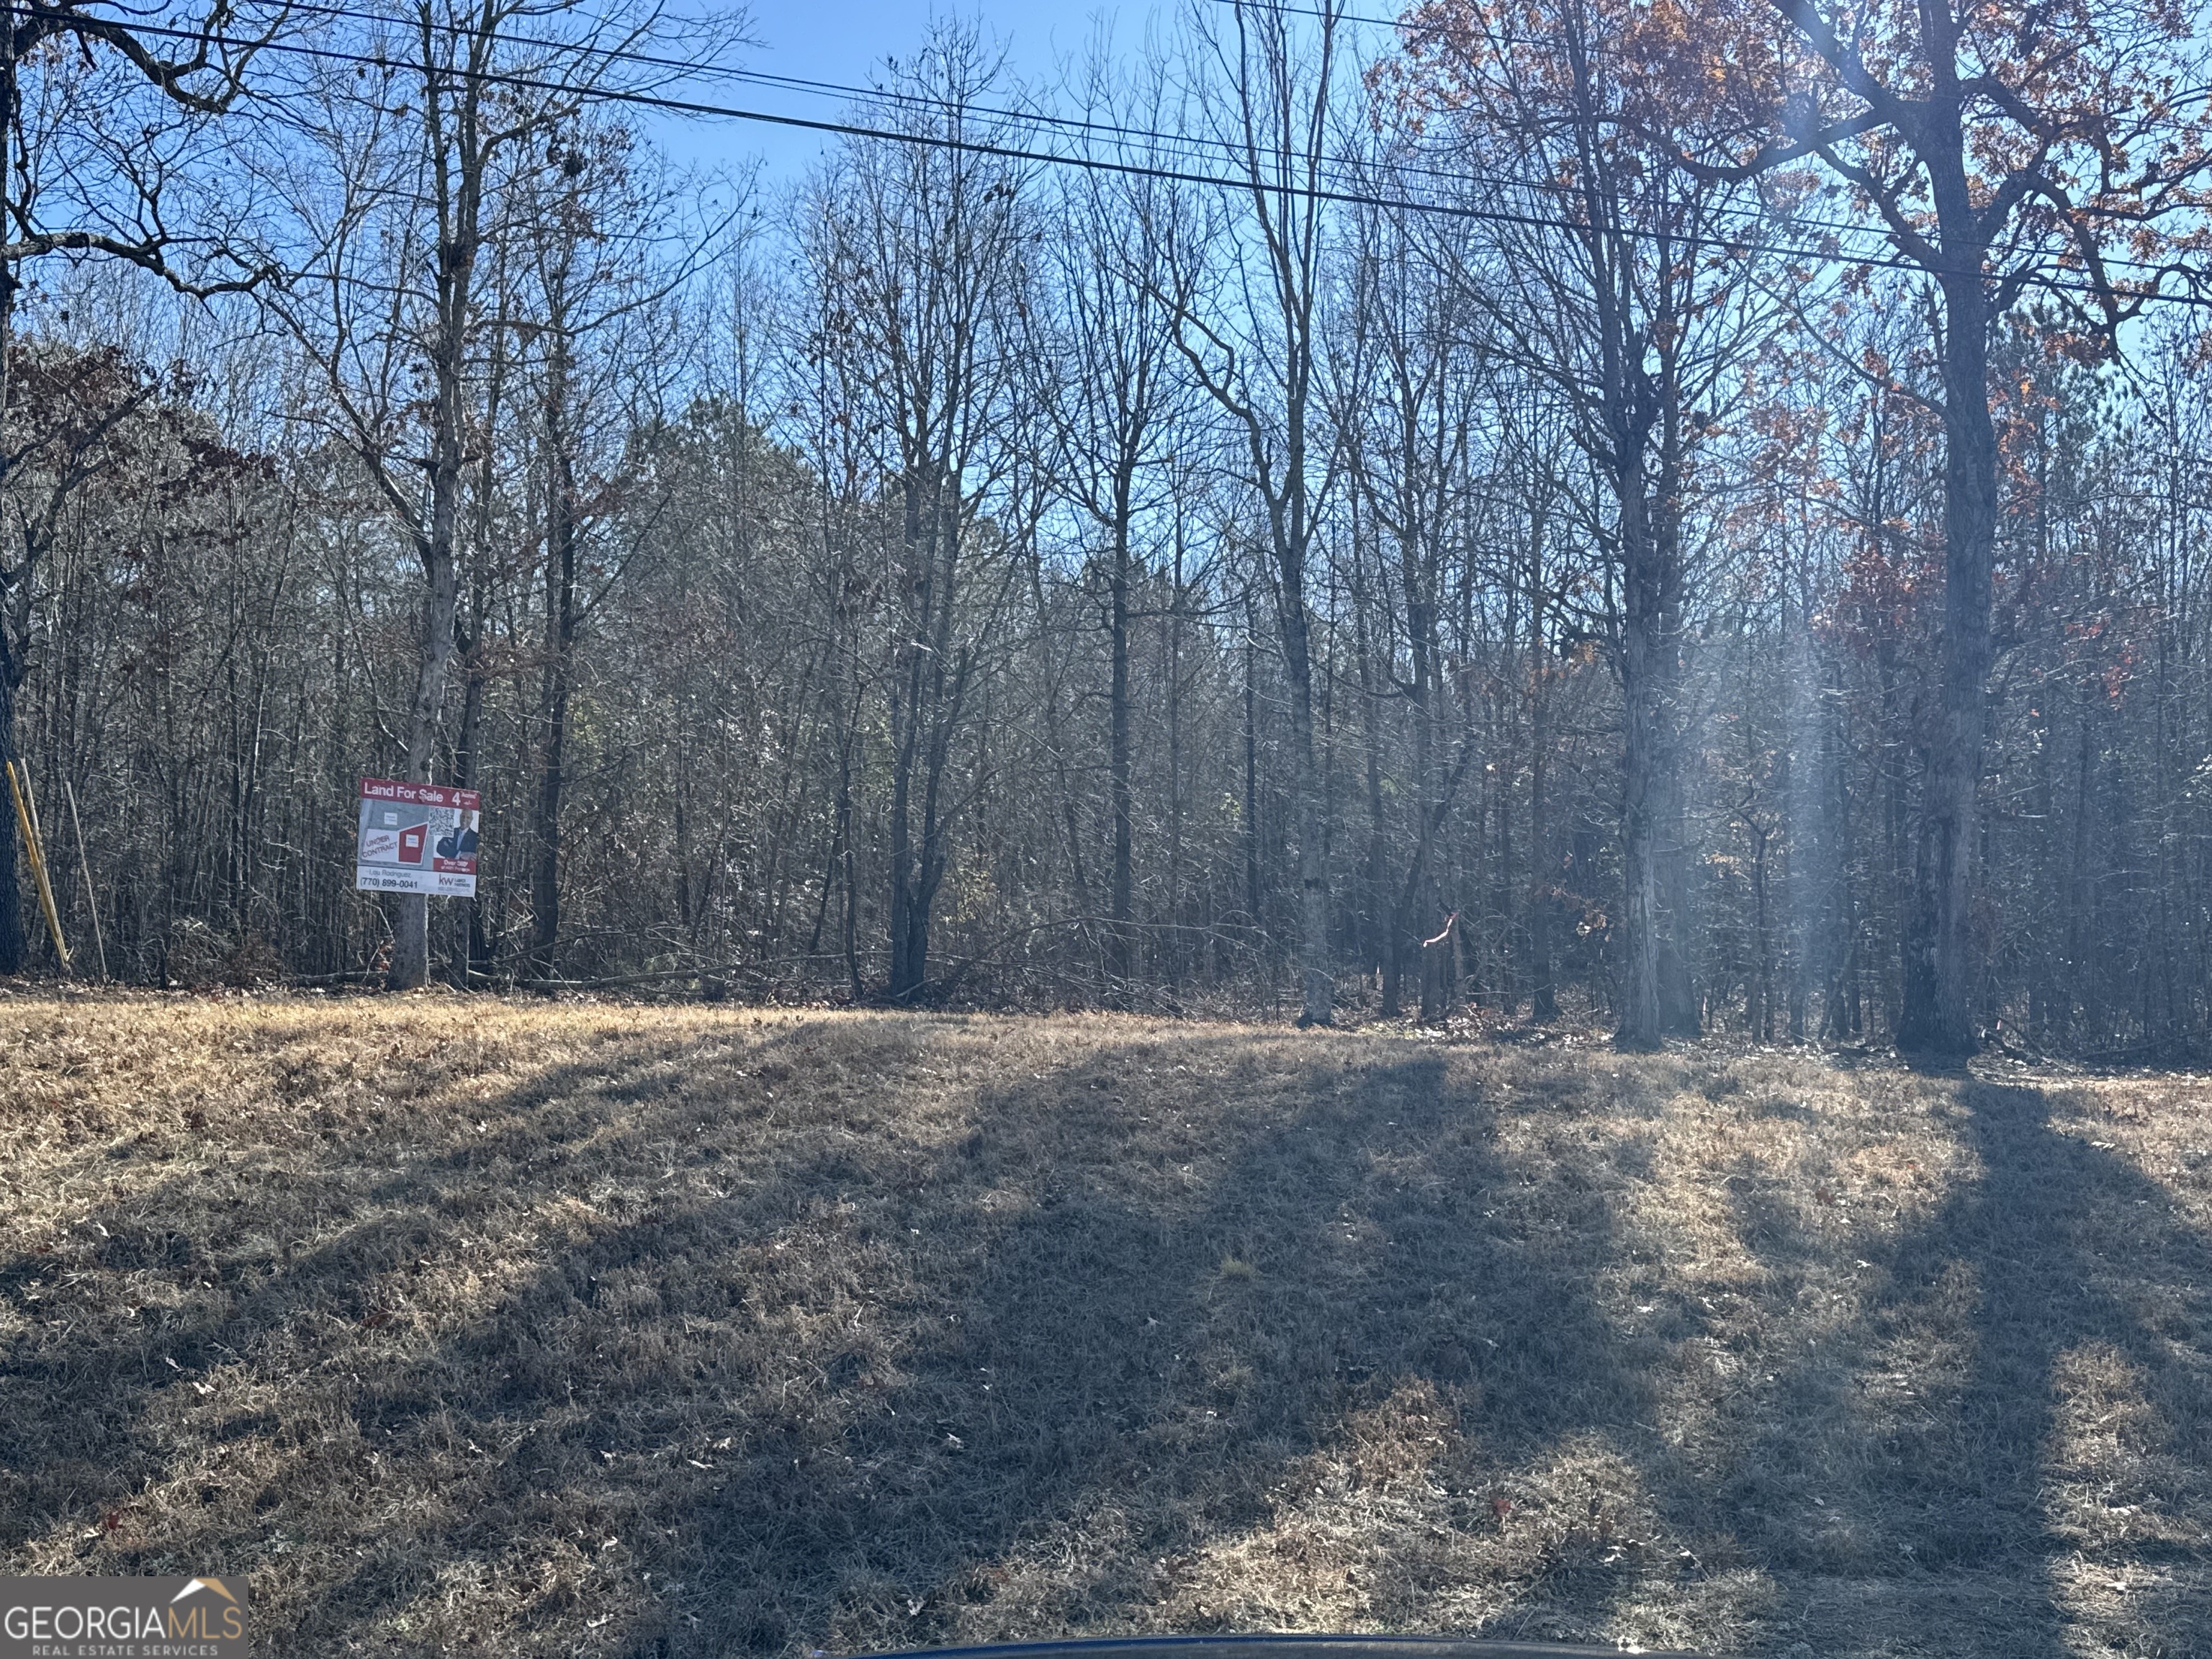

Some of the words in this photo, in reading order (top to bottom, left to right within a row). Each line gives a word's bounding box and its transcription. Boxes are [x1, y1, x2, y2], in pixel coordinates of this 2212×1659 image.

[364, 782, 394, 797] Land
[397, 786, 416, 799] For
[419, 788, 444, 802] Sale
[452, 792, 461, 806] 4
[366, 835, 390, 847] UNDER
[362, 842, 397, 858] CONTRACT
[360, 878, 379, 887] (770)
[382, 879, 418, 889] 899-0041
[439, 873, 454, 886] kw
